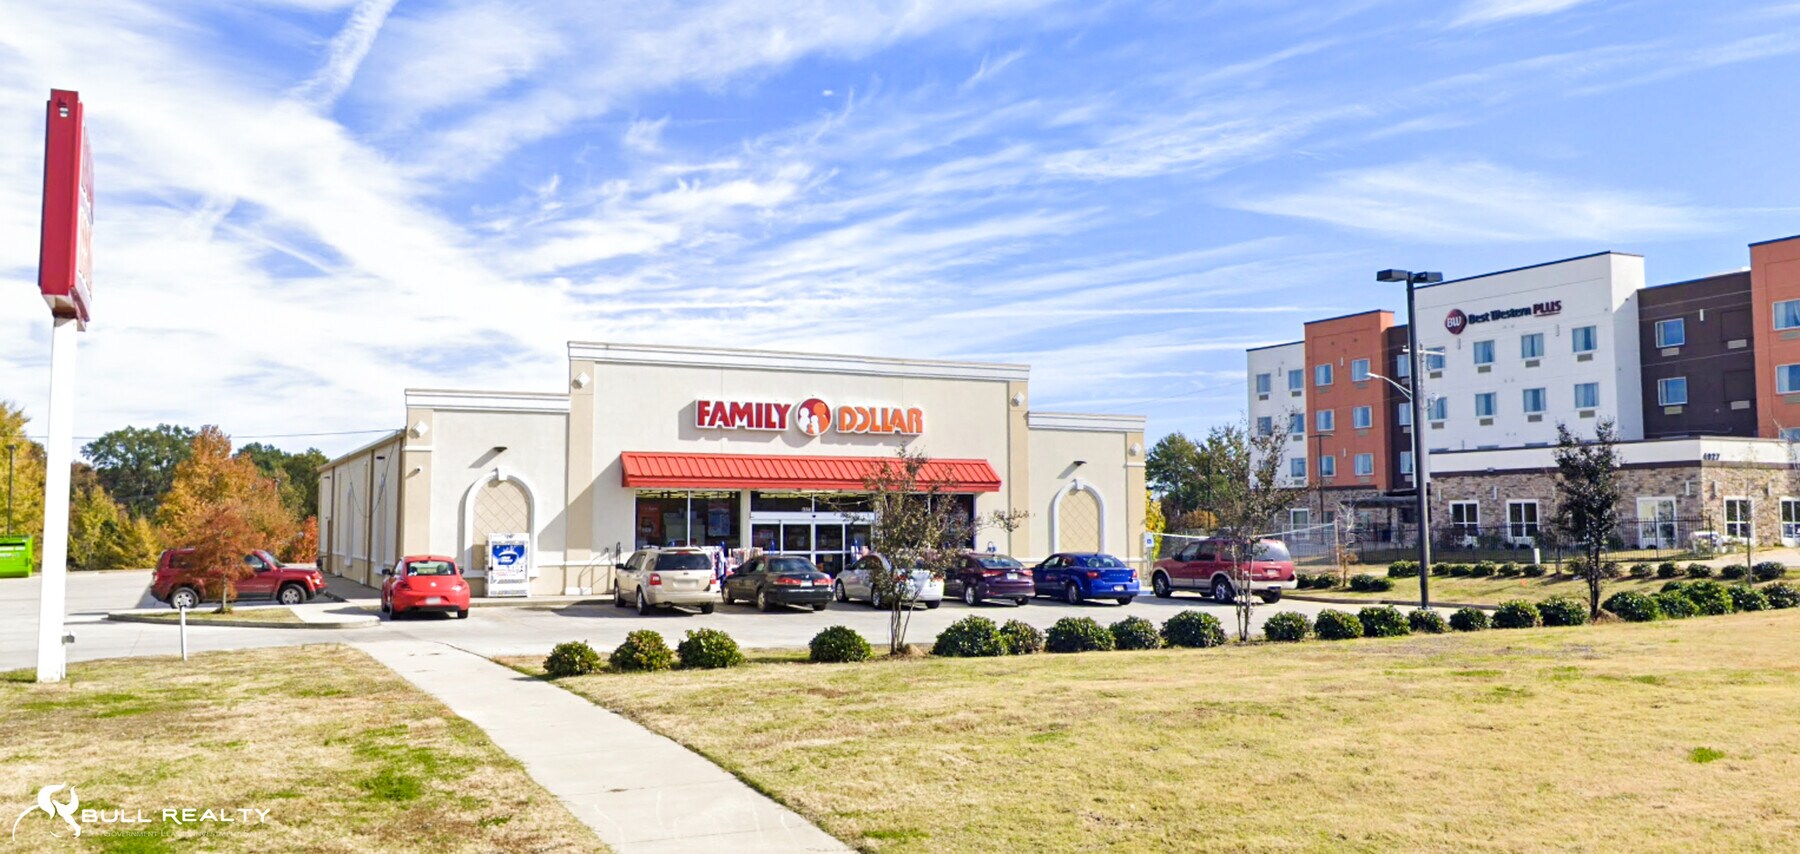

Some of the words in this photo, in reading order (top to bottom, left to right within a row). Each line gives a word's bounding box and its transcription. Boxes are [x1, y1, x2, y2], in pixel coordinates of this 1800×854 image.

[1446, 315, 1462, 328] BW
[1468, 313, 1490, 325] Best
[1490, 307, 1532, 321] Western
[1533, 300, 1562, 315] PLUS
[697, 400, 792, 430] FAMILY
[837, 406, 923, 434] DOLLAR
